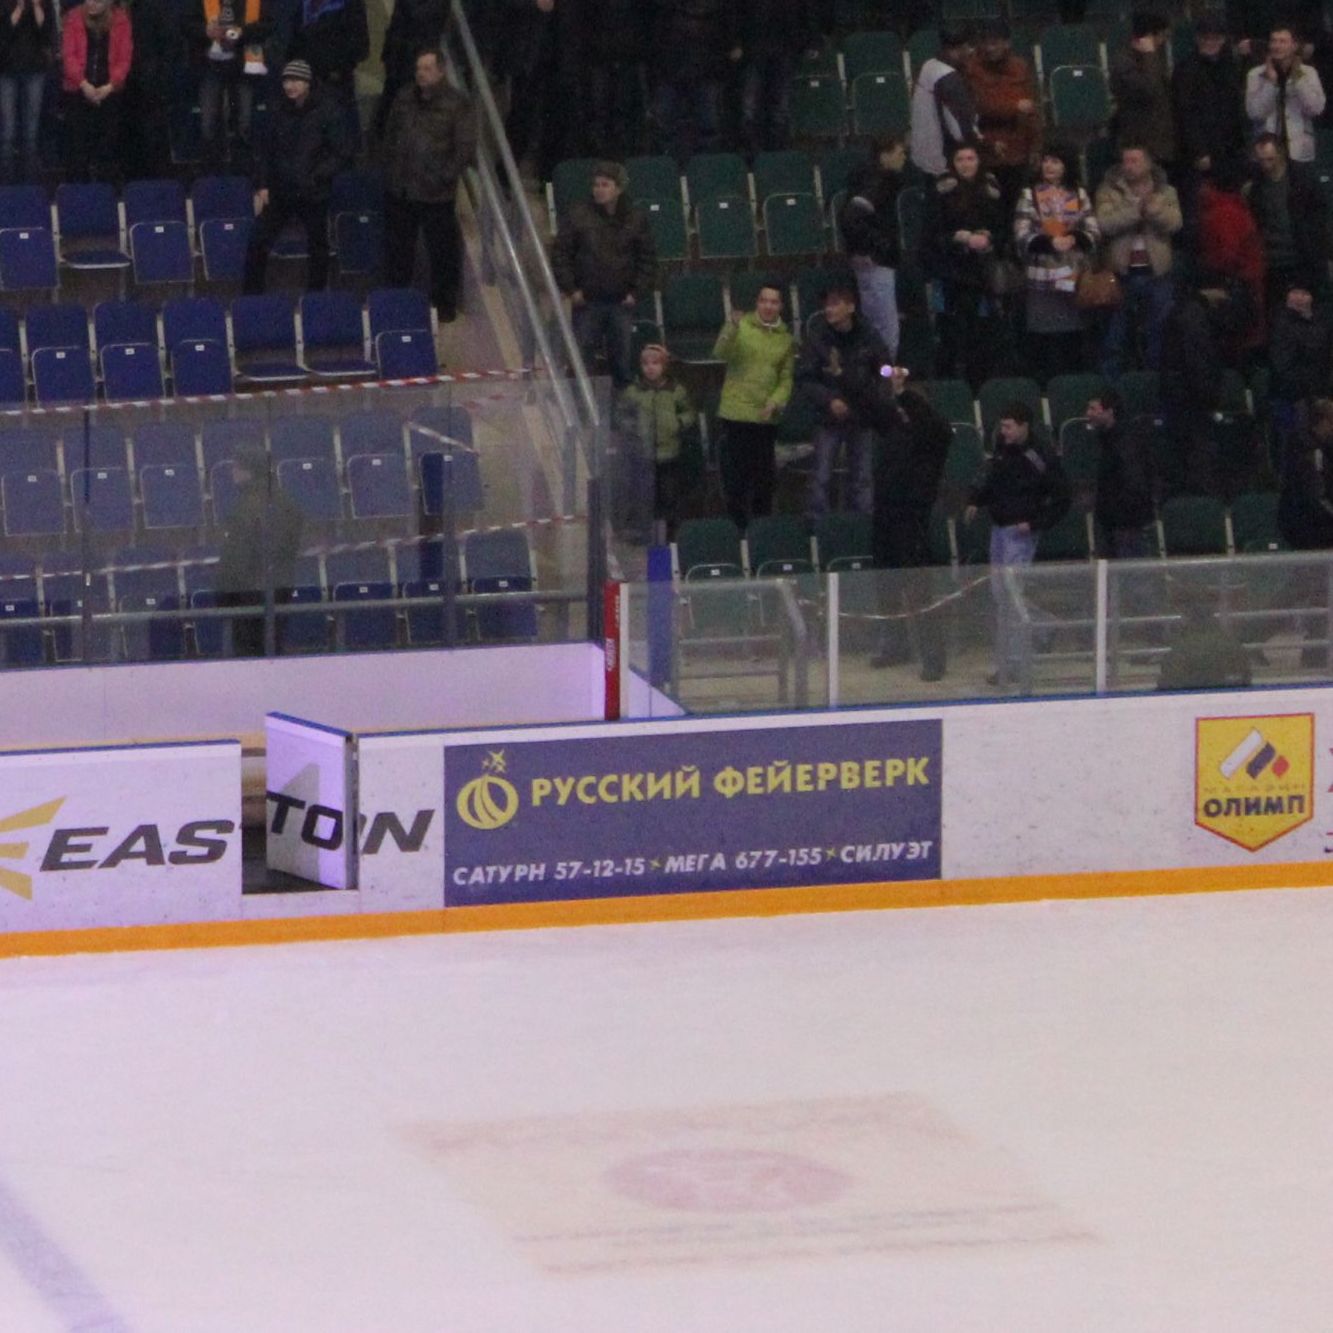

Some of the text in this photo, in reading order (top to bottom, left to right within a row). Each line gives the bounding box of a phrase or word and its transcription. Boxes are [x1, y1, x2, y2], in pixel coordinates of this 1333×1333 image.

[532, 757, 931, 808] РУССКИЙ ФЕЙЕРВЕРК
[1204, 795, 1305, 818] ОЛИМП
[452, 839, 934, 886] САТУРН 57-12-15 МЕГА 677-155 СИЛУЭТ
